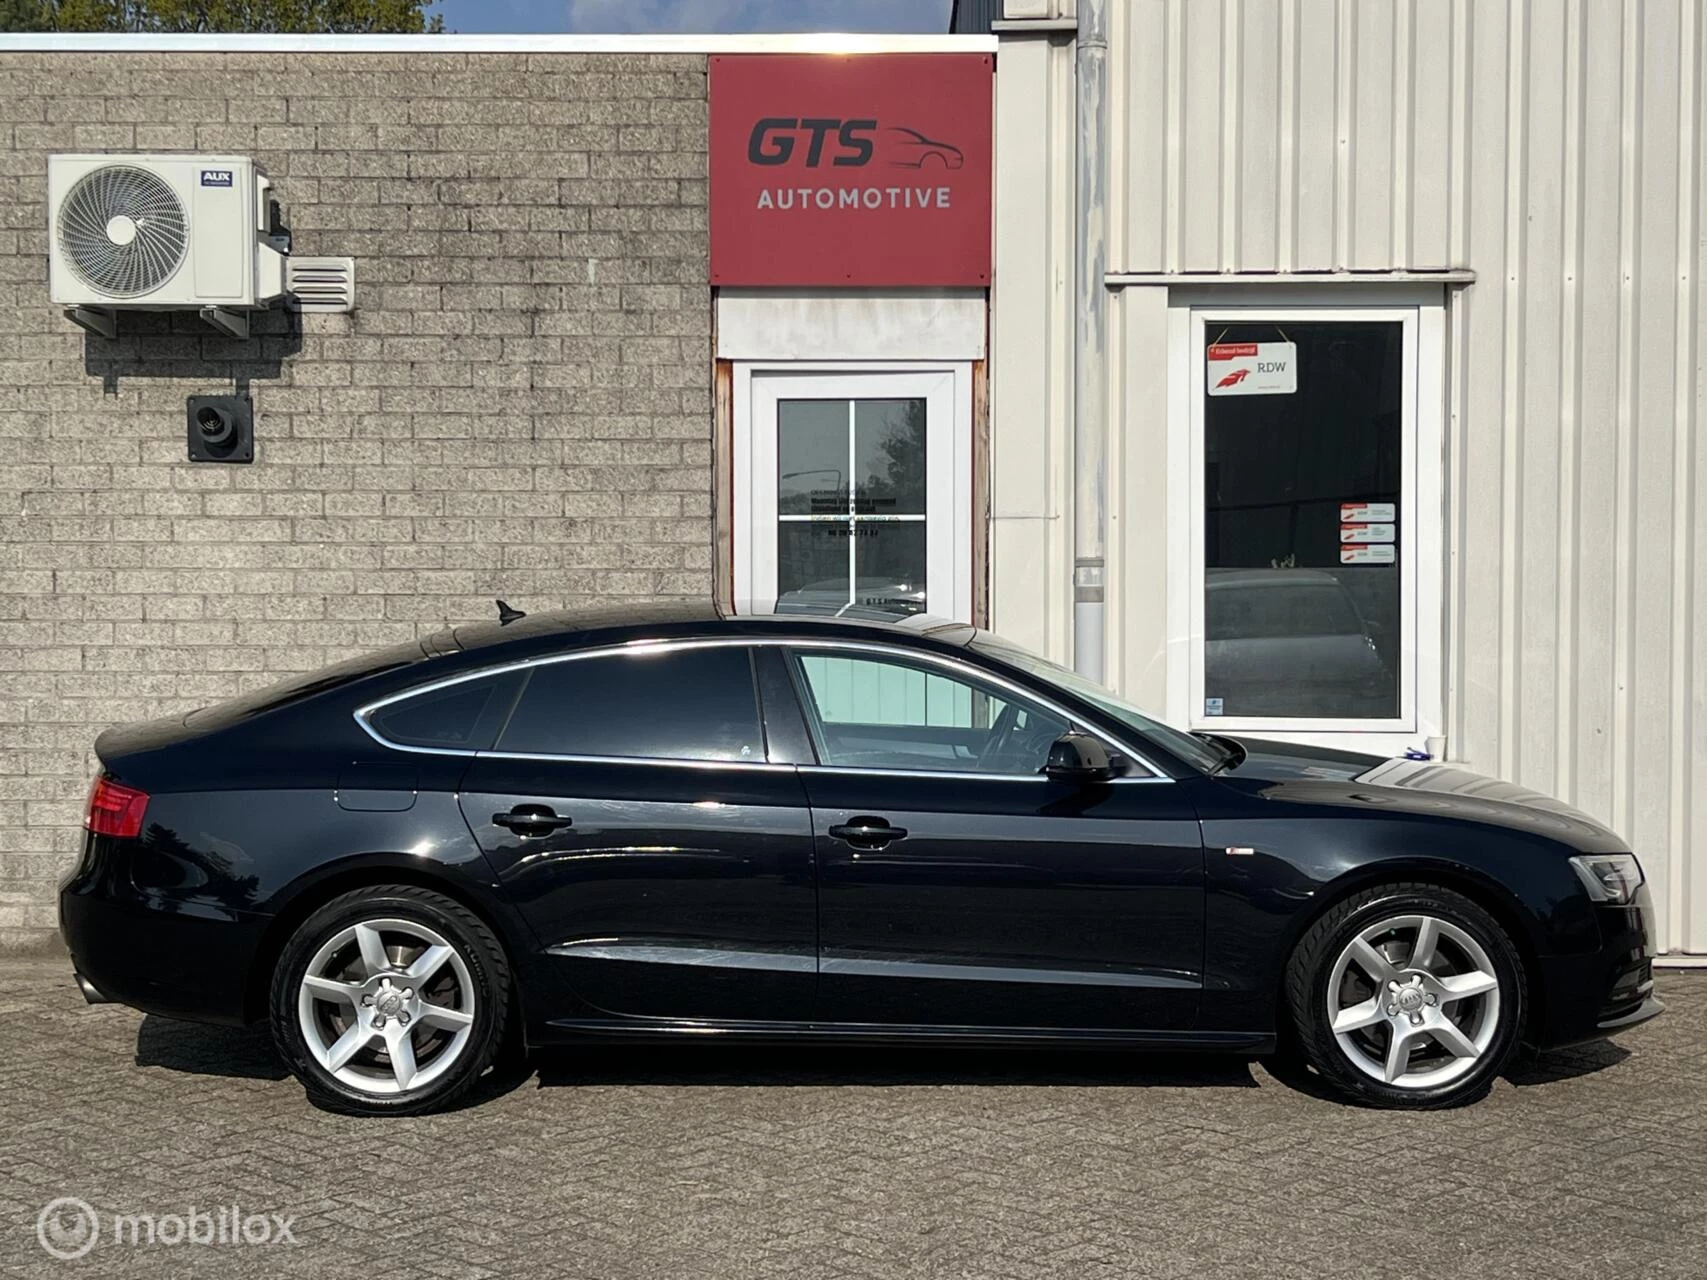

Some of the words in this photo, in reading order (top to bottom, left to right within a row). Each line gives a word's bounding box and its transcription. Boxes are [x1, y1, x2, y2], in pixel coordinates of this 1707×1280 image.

[747, 117, 878, 168] GTS
[203, 172, 230, 181] AUX
[757, 187, 951, 210] AUTOMOTIVE
[1257, 362, 1286, 373] RDW
